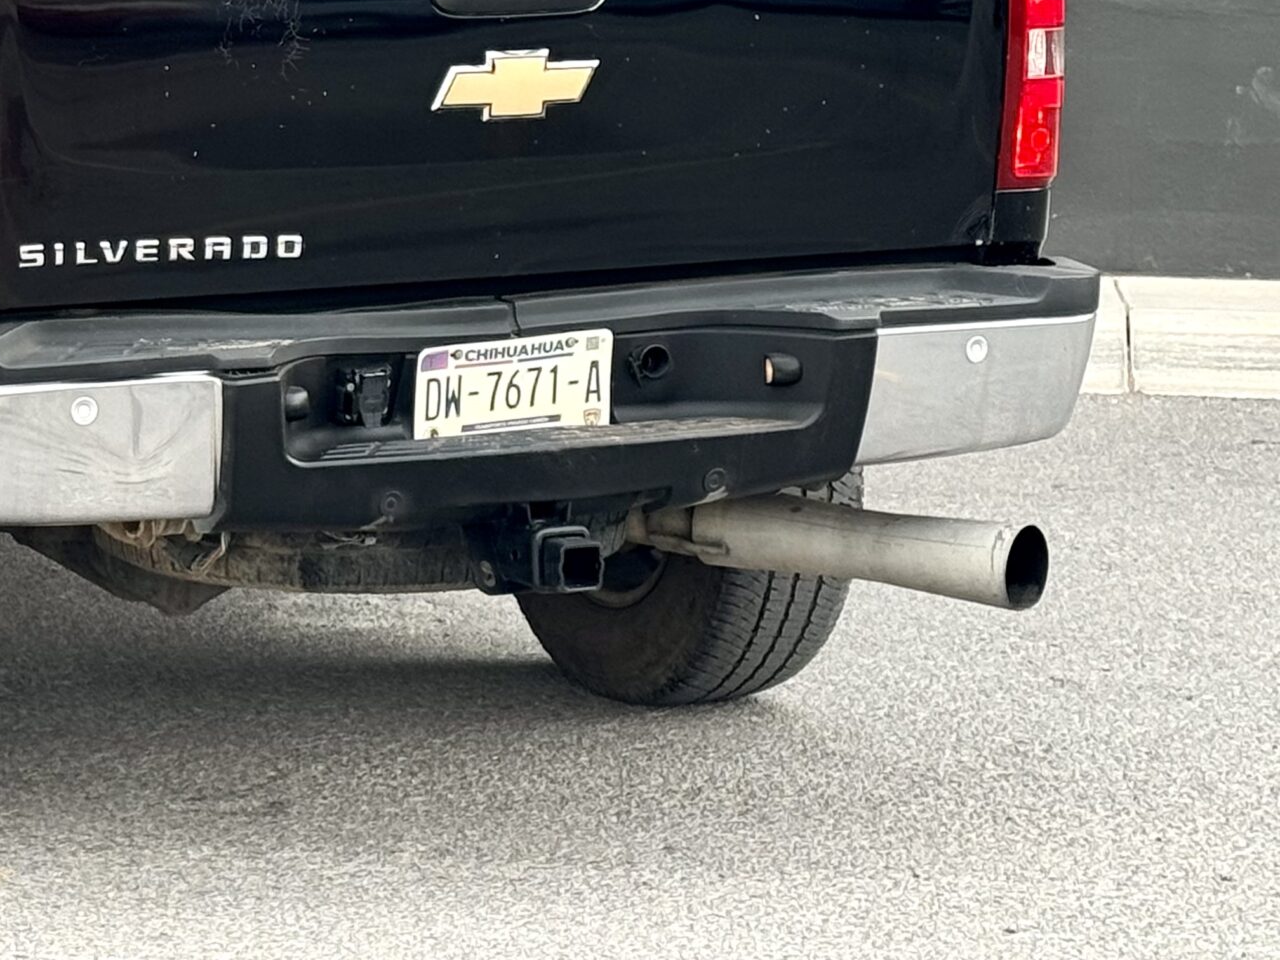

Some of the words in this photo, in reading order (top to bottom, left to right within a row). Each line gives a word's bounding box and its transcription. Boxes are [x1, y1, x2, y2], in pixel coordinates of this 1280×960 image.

[19, 234, 304, 268] SILVERADO
[465, 339, 565, 362] CHIHUAHUA
[424, 359, 602, 422] DW-7671-A
